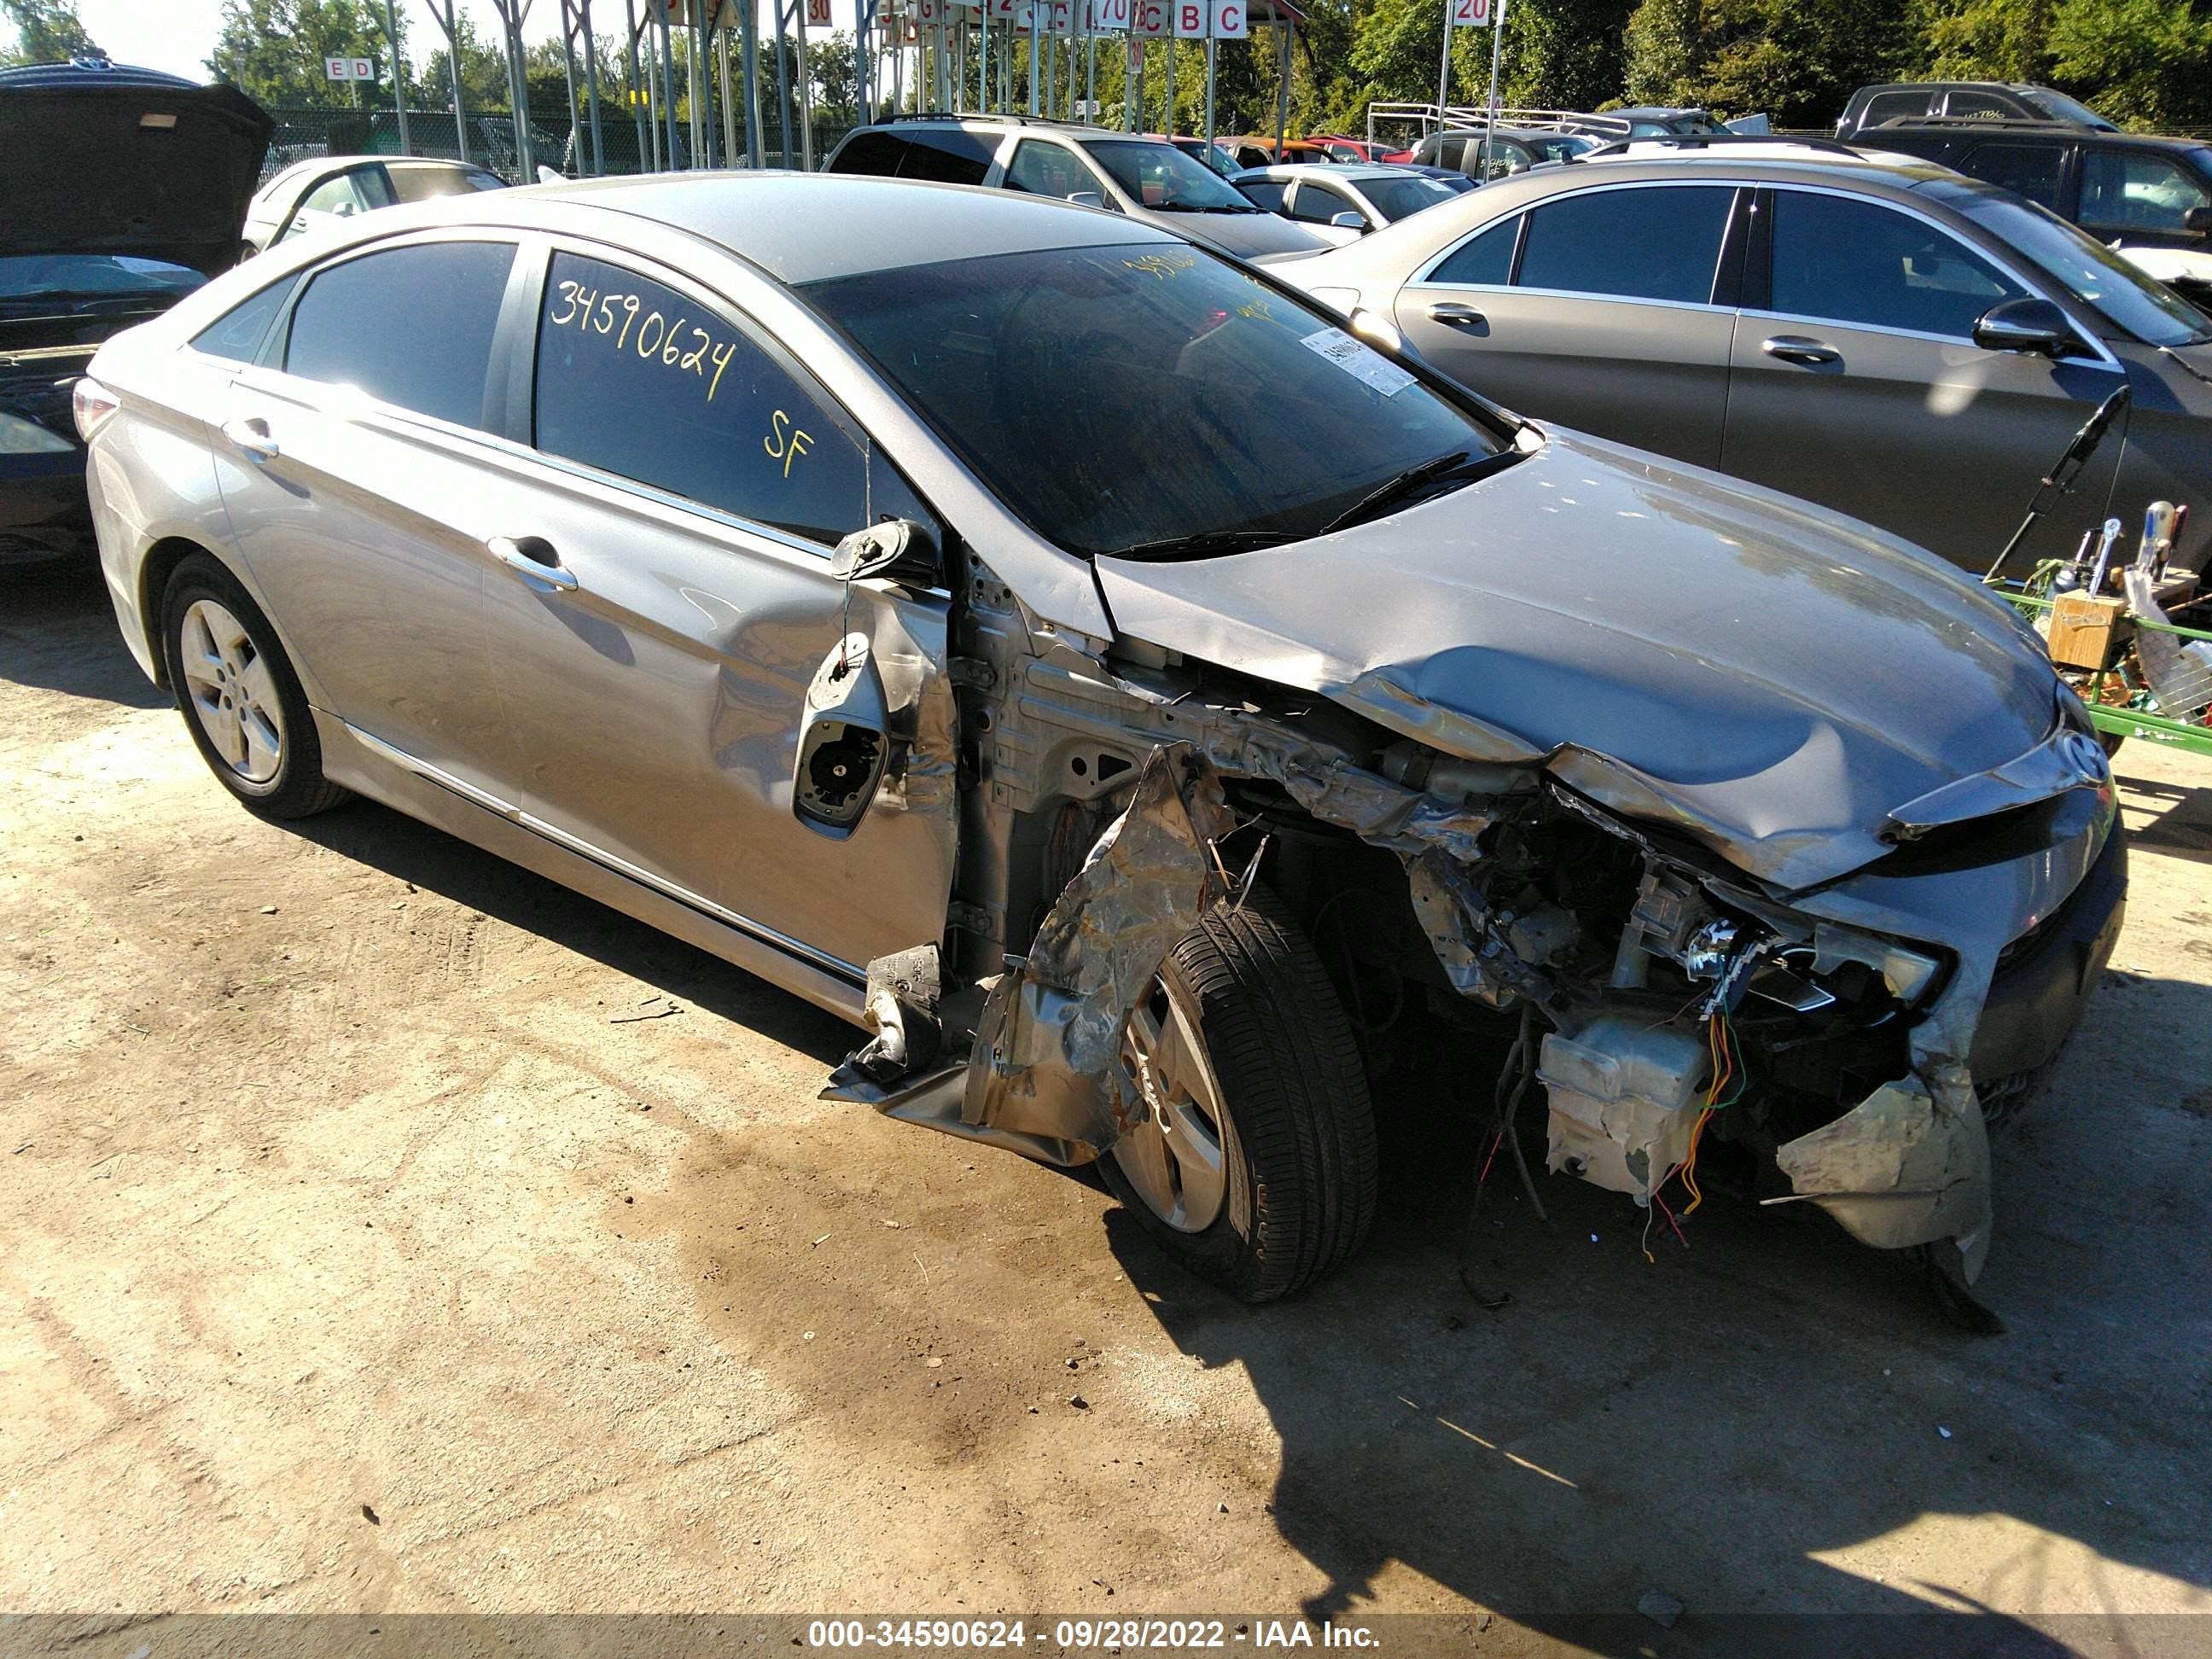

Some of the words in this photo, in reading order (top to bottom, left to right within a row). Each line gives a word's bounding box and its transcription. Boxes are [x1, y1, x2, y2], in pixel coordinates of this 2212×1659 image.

[809, 0, 830, 20] 30
[1103, 0, 1126, 20] 70
[1182, 5, 1200, 31] B
[1221, 6, 1239, 32] C
[1458, 0, 1487, 19] 20
[331, 62, 343, 75] E
[357, 62, 369, 76] D
[551, 281, 737, 403] 34590624
[764, 410, 815, 478] SF
